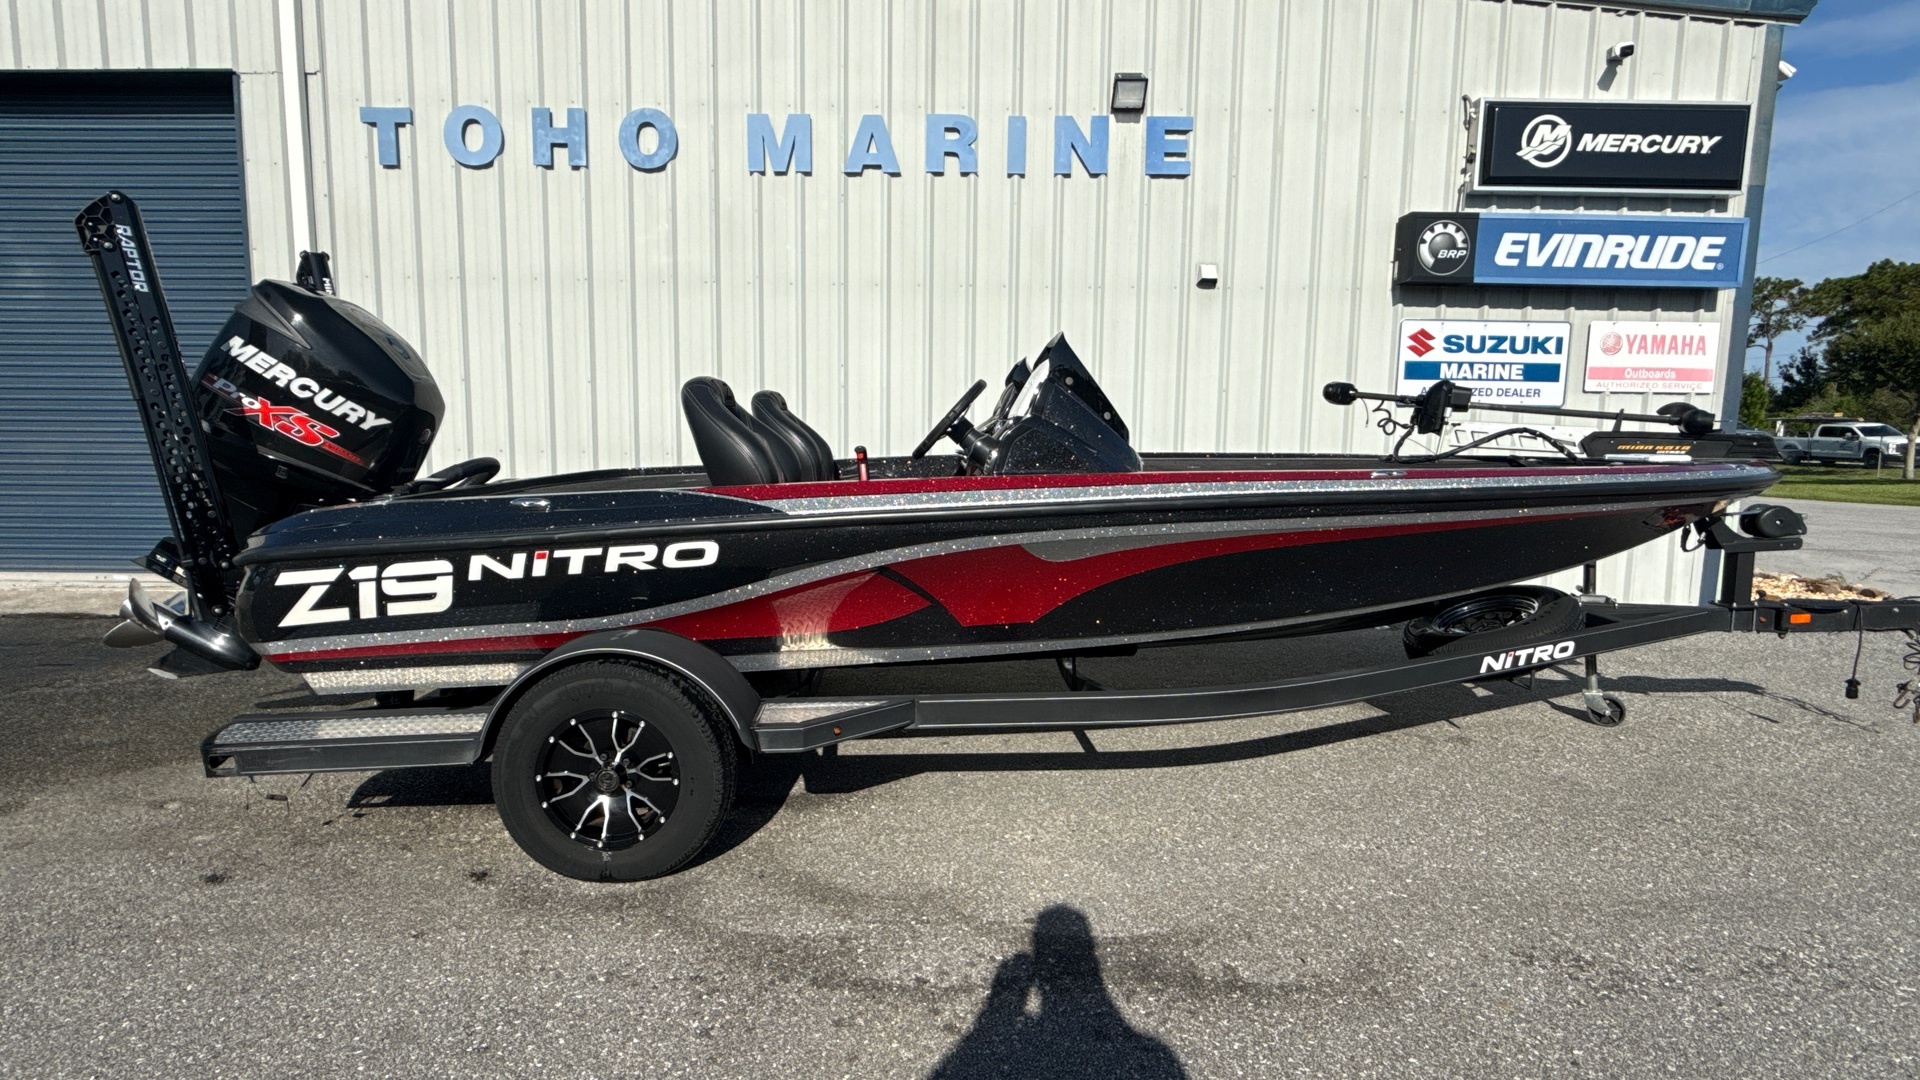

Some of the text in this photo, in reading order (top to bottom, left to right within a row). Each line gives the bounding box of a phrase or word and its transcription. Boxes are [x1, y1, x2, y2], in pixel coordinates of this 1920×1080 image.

[359, 105, 1194, 176] TOHO MARINE
[1576, 133, 1722, 154] MERCURY
[115, 224, 149, 292] RAPTOR
[1437, 249, 1467, 259] BRP
[1494, 232, 1726, 270] EVINRUDE
[1442, 334, 1563, 355] SUZUKI
[1625, 333, 1707, 356] YAMAHA
[1439, 362, 1524, 380] MARINE
[1624, 368, 1677, 379] Outboards
[220, 335, 392, 431] MERCURY
[1496, 388, 1541, 398] DEALER
[1596, 381, 1703, 390] AUTHORIZED SERVICE
[223, 396, 341, 446] XS
[274, 559, 454, 628] Z19
